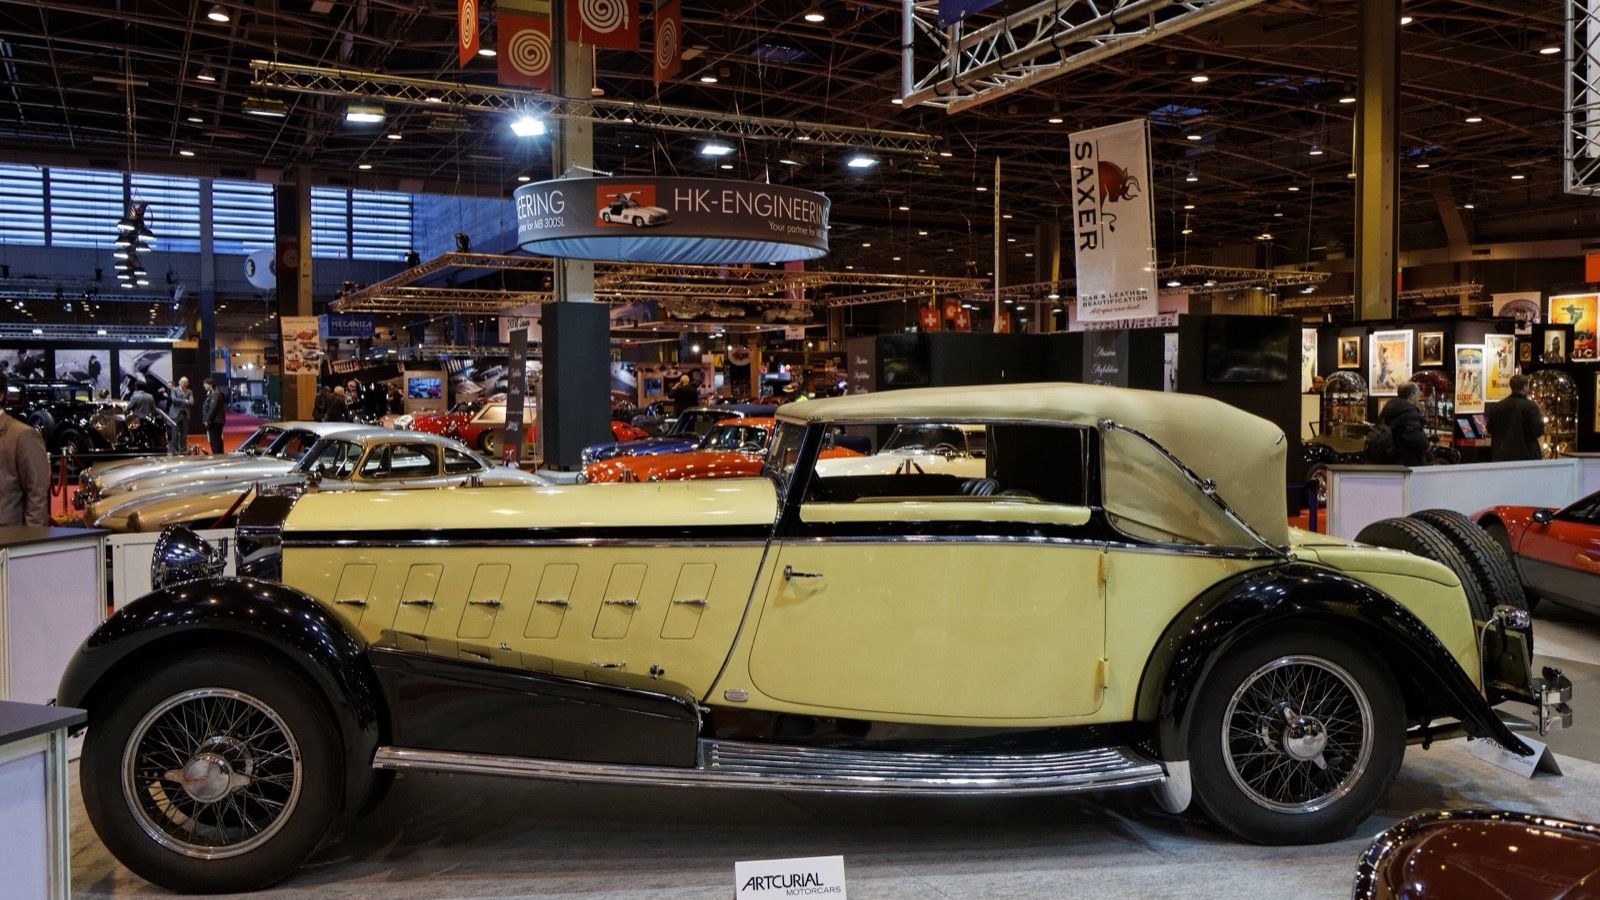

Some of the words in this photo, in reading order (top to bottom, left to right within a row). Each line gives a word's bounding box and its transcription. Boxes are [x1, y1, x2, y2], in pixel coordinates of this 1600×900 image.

[1074, 140, 1098, 252] SAXER
[545, 217, 565, 228] 300SL
[768, 220, 786, 232] Your
[787, 224, 808, 236] partner
[1082, 294, 1099, 302] CAR
[1109, 289, 1148, 299] LEATHER
[1082, 295, 1148, 308] BEAUTIFICATION
[741, 872, 825, 892] ARTCURIAL
[785, 885, 842, 897] MOTORCARS
